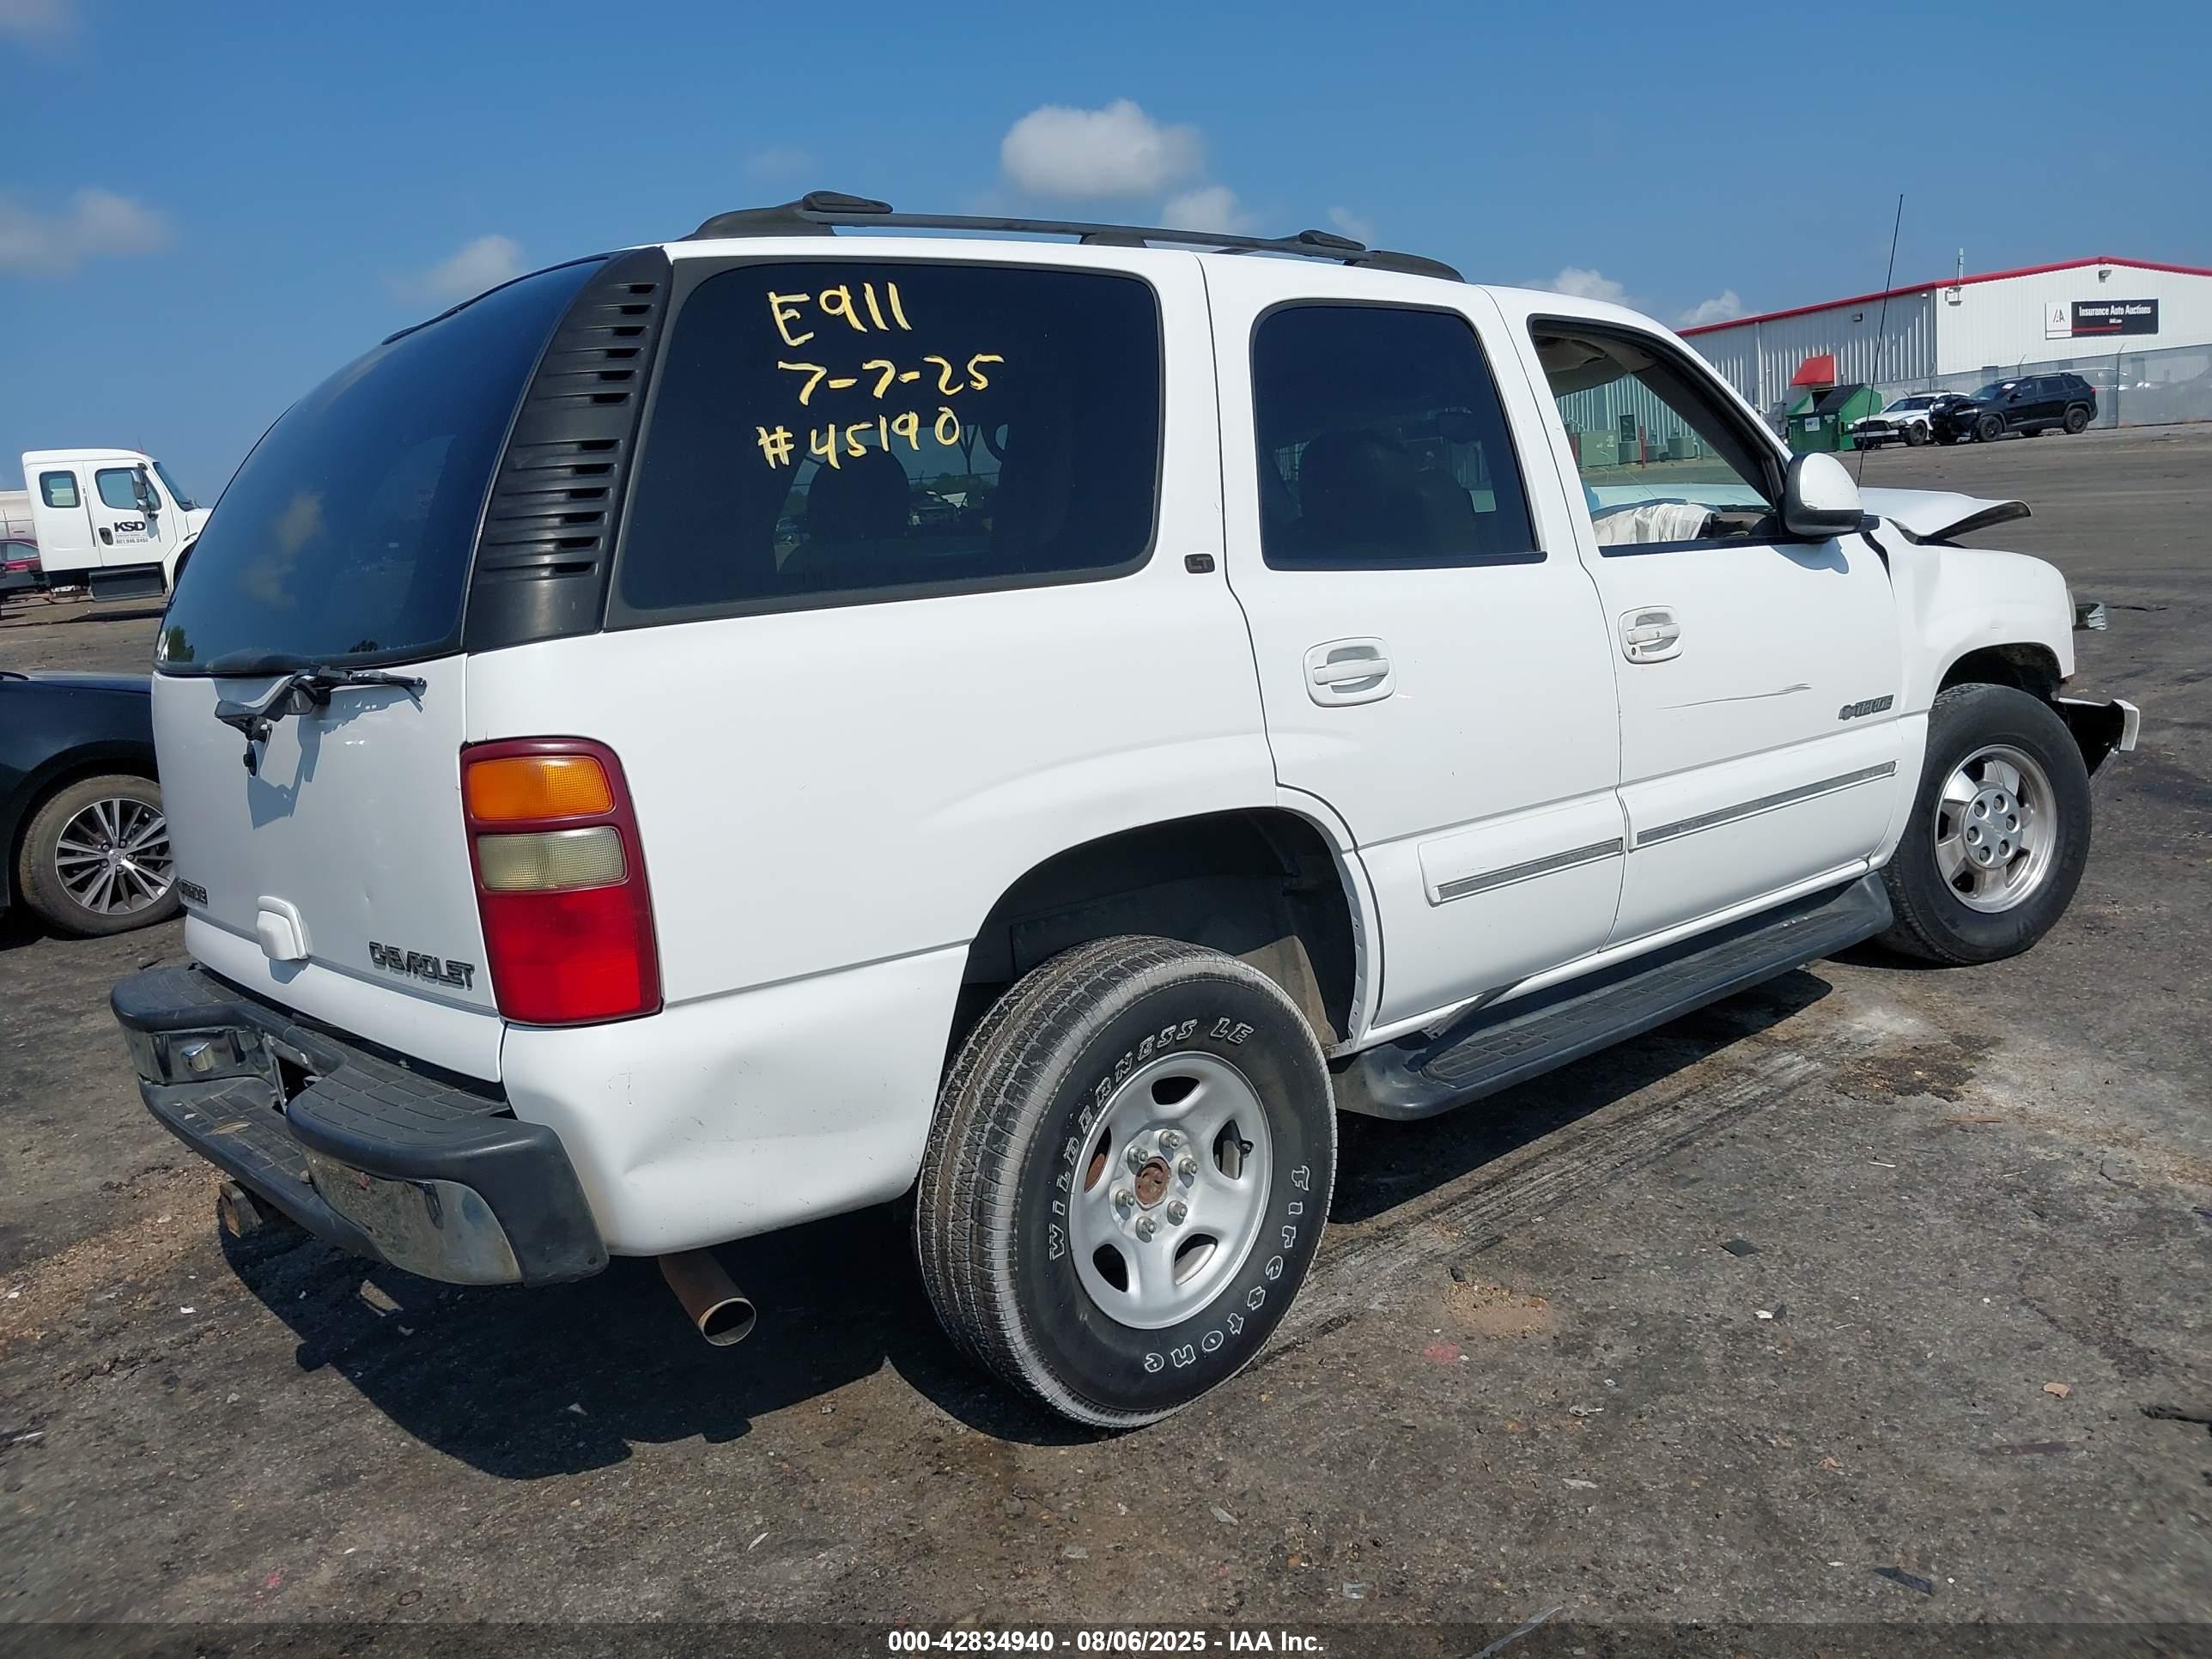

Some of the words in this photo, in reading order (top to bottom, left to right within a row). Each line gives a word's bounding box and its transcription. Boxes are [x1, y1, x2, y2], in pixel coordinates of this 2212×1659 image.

[767, 282, 913, 346] E911
[2079, 306, 2109, 317] Insurance
[2110, 305, 2124, 316] Auto
[2124, 304, 2151, 315] Auctions
[777, 353, 1005, 405] 7-7-25
[756, 406, 960, 470] #45190
[113, 520, 146, 532] KSD
[368, 940, 476, 989] CHEVROLET
[1049, 1018, 1198, 1261] WILDERNESS
[1211, 1017, 1254, 1044] LE
